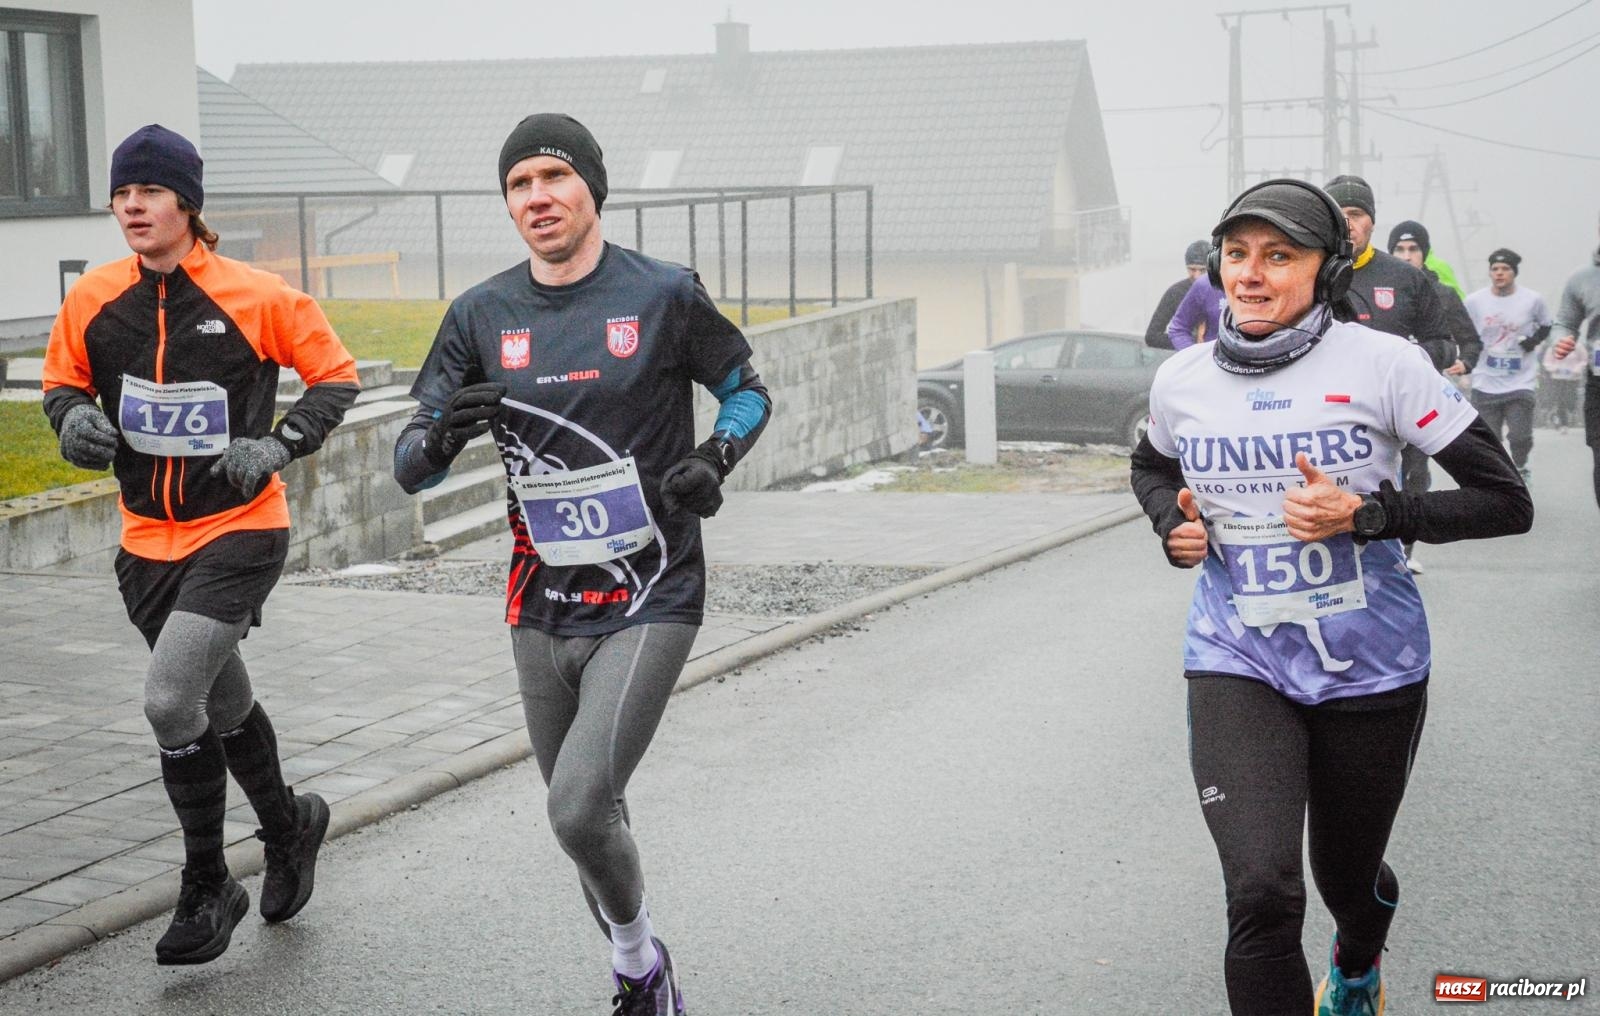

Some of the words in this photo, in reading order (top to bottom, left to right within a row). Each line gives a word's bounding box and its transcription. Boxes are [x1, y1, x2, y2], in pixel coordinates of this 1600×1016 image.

[540, 146, 573, 163] KALENJI
[1496, 357, 1511, 369] 15
[137, 403, 209, 435] 176
[1177, 423, 1373, 472] RUNNERS
[1195, 482, 1286, 494] EKO-OKNA
[555, 498, 610, 538] 30
[1236, 541, 1333, 592] 150
